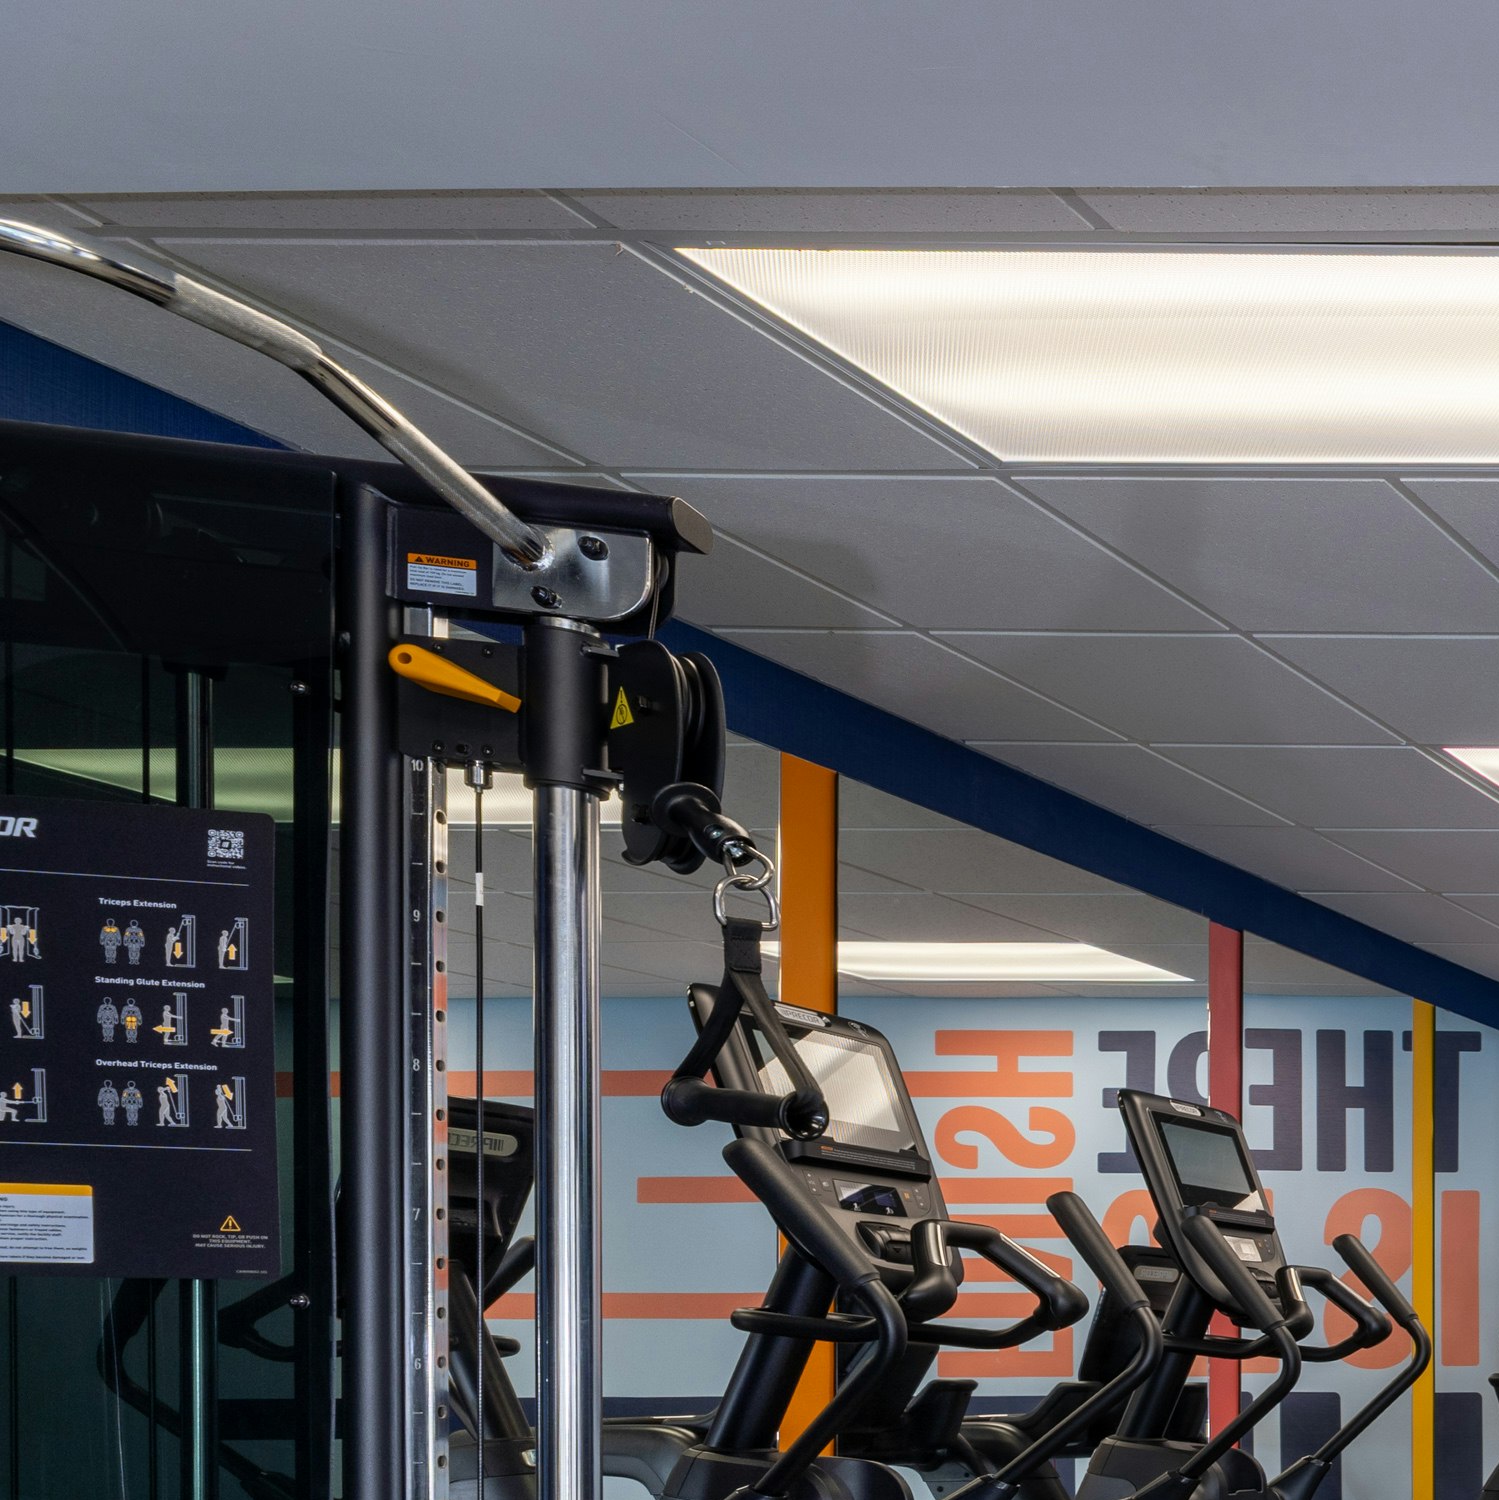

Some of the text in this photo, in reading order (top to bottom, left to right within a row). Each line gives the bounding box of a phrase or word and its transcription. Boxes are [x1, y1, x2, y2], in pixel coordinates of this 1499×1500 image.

[426, 556, 470, 567] WARNING
[411, 760, 423, 771] 10
[99, 898, 177, 909] Triceps Extension
[414, 910, 420, 921] 9
[95, 976, 134, 986] Standing
[162, 980, 206, 989] Extension
[96, 1059, 218, 1071] Overhead Triceps Extension
[413, 1059, 420, 1071] 8
[413, 1208, 420, 1220] 7
[415, 1358, 421, 1369] 6
